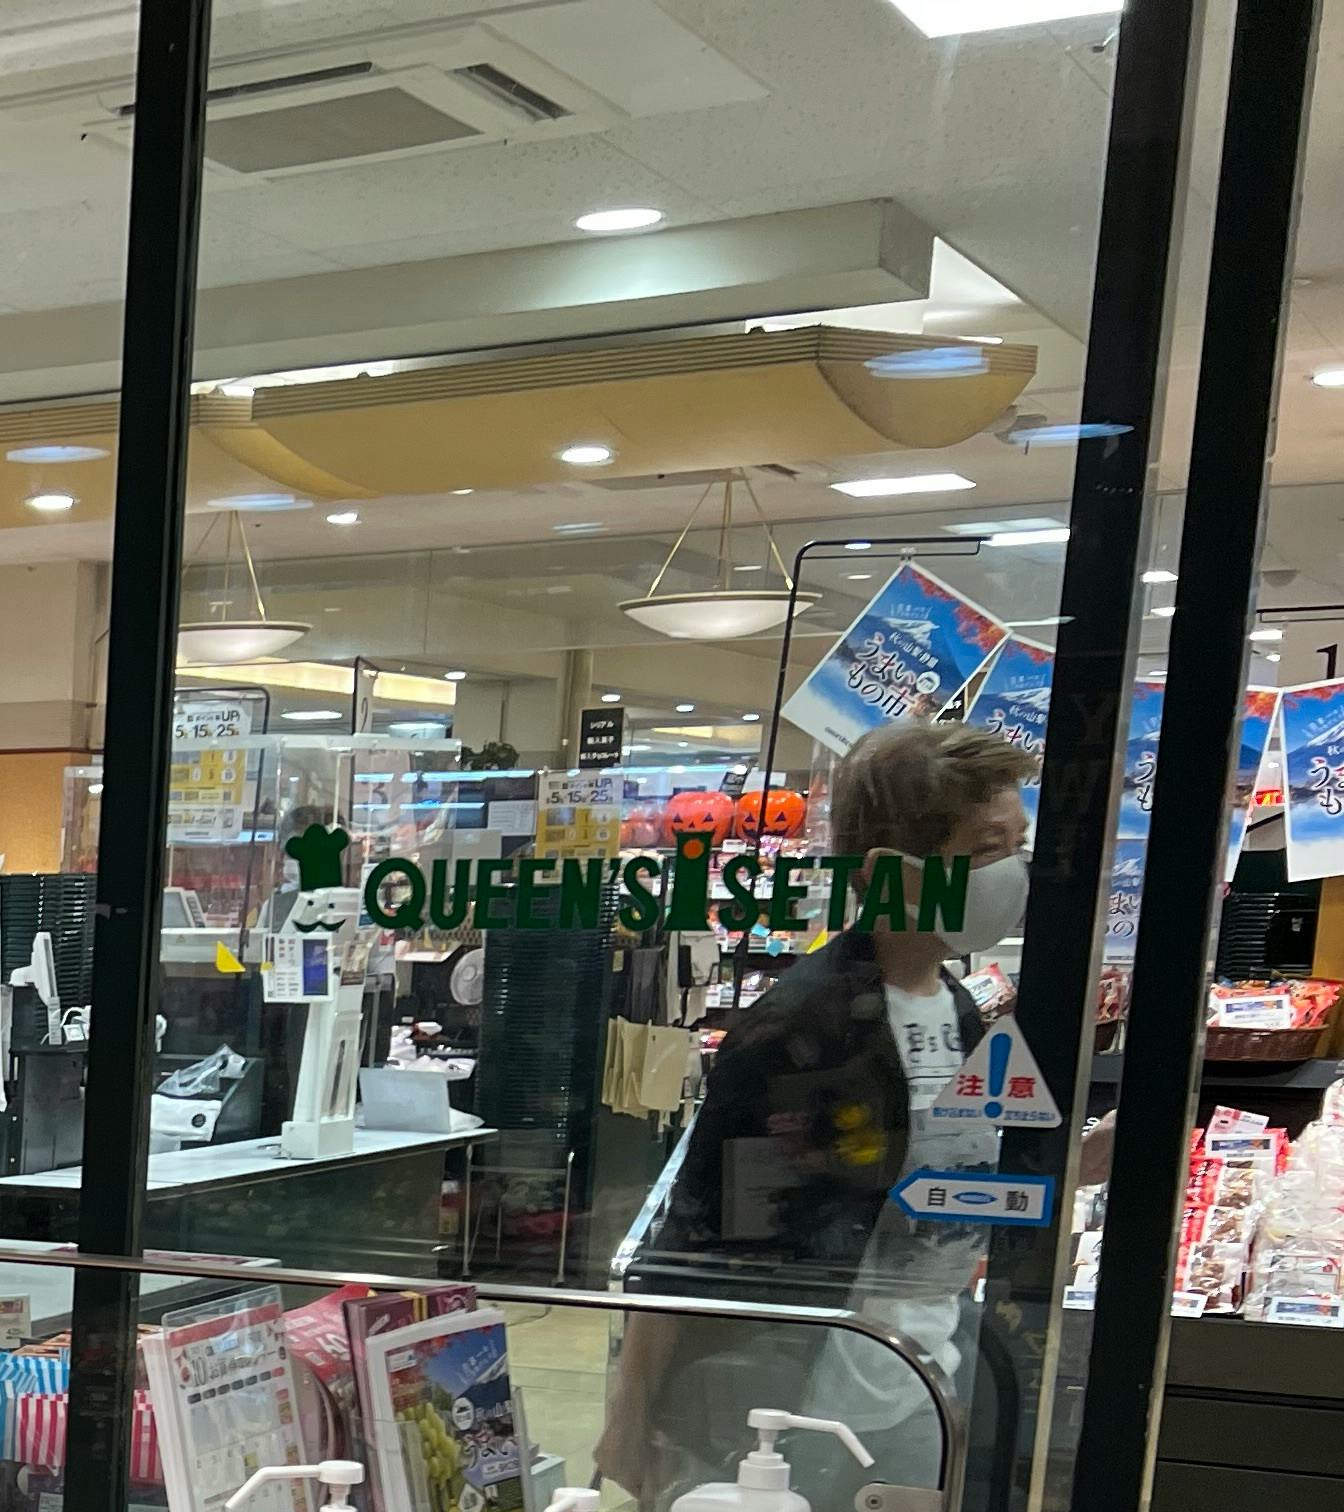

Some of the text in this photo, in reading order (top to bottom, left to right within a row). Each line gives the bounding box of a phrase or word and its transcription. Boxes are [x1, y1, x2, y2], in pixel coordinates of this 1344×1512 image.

[856, 631, 916, 687] うまい
[848, 660, 915, 719] もの市
[363, 831, 972, 934] QUEEN'S ISETAN
[956, 1073, 1037, 1099] 注意
[927, 1186, 1030, 1212] 自動
